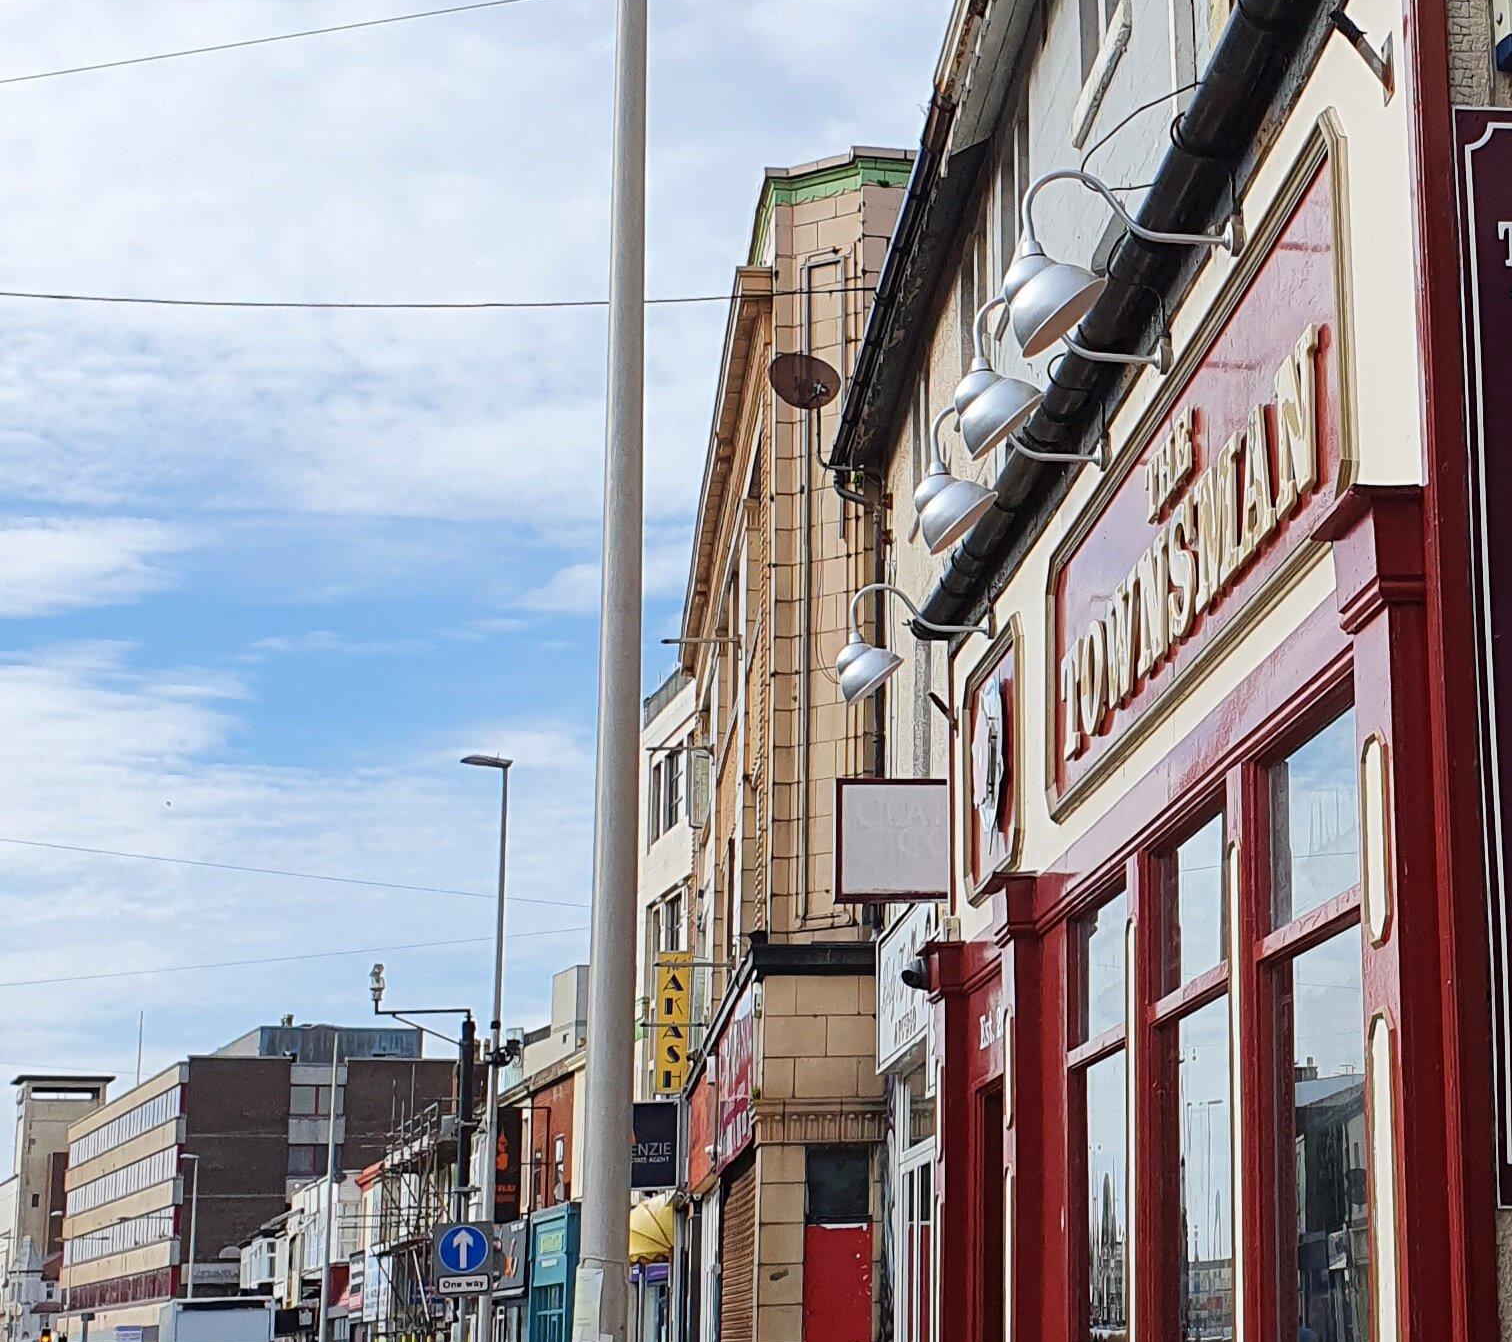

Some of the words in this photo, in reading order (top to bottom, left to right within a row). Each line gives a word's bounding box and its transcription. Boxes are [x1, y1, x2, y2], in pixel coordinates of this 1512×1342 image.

[1145, 407, 1193, 525] THE
[1061, 323, 1318, 761] TOWNSMAN
[443, 1281, 462, 1289] One
[466, 1280, 484, 1289] way
